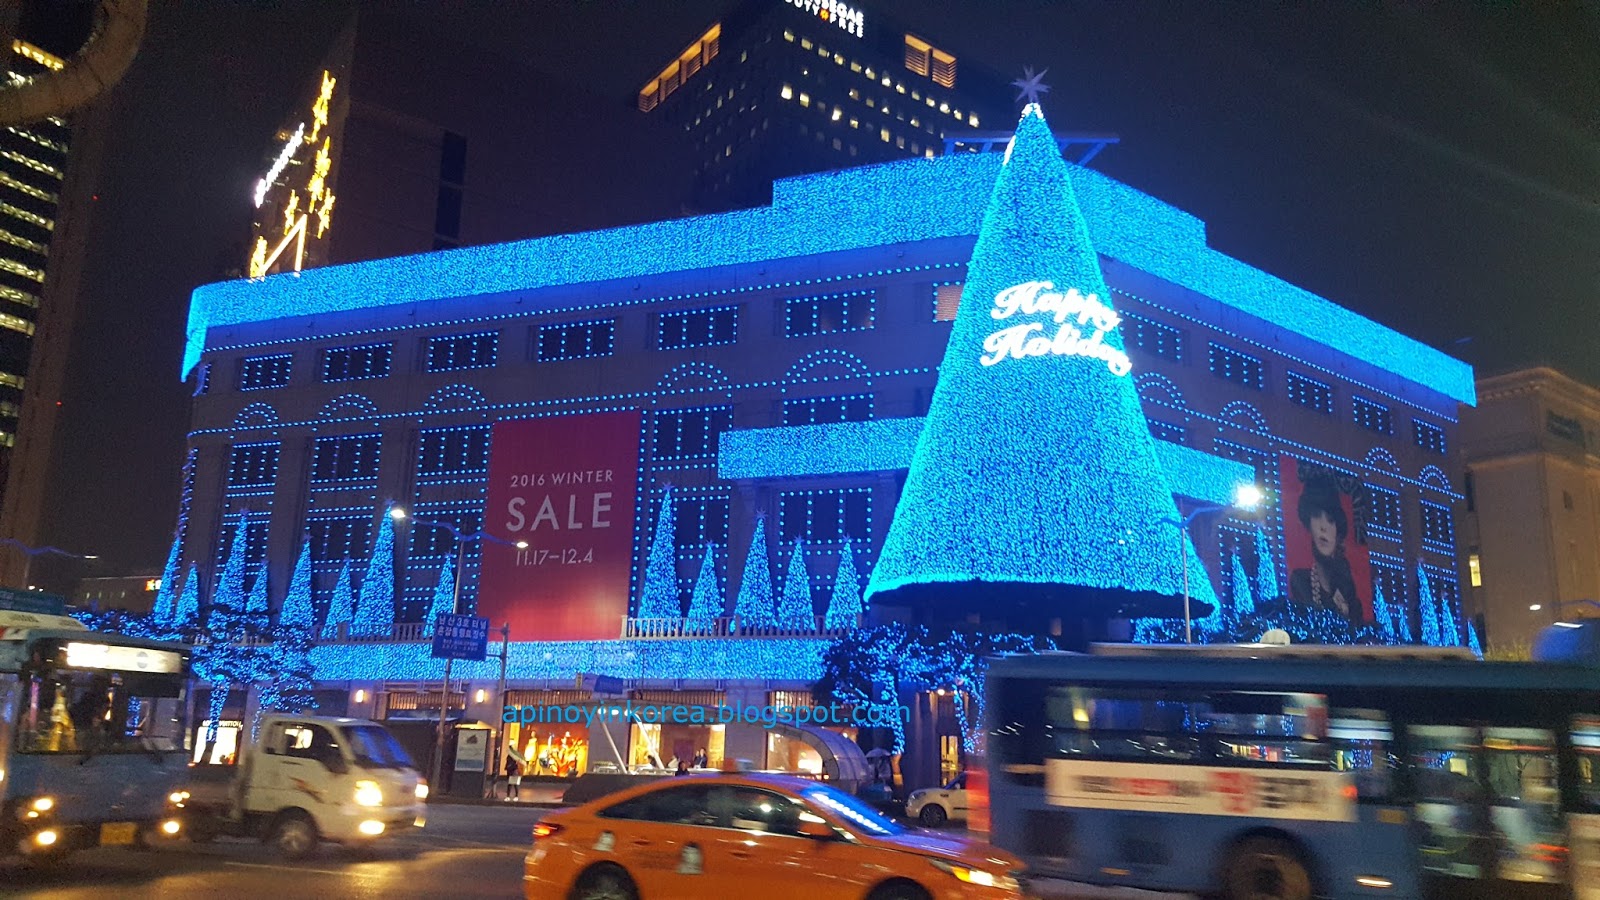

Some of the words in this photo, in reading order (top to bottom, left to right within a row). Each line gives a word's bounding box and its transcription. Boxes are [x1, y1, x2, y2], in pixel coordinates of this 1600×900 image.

[785, 0, 820, 16] UTY
[990, 281, 1122, 332] Happy
[980, 323, 1133, 377] Holiday
[510, 474, 545, 488] 2016
[552, 469, 613, 485] WINTER
[505, 492, 613, 532] SALE
